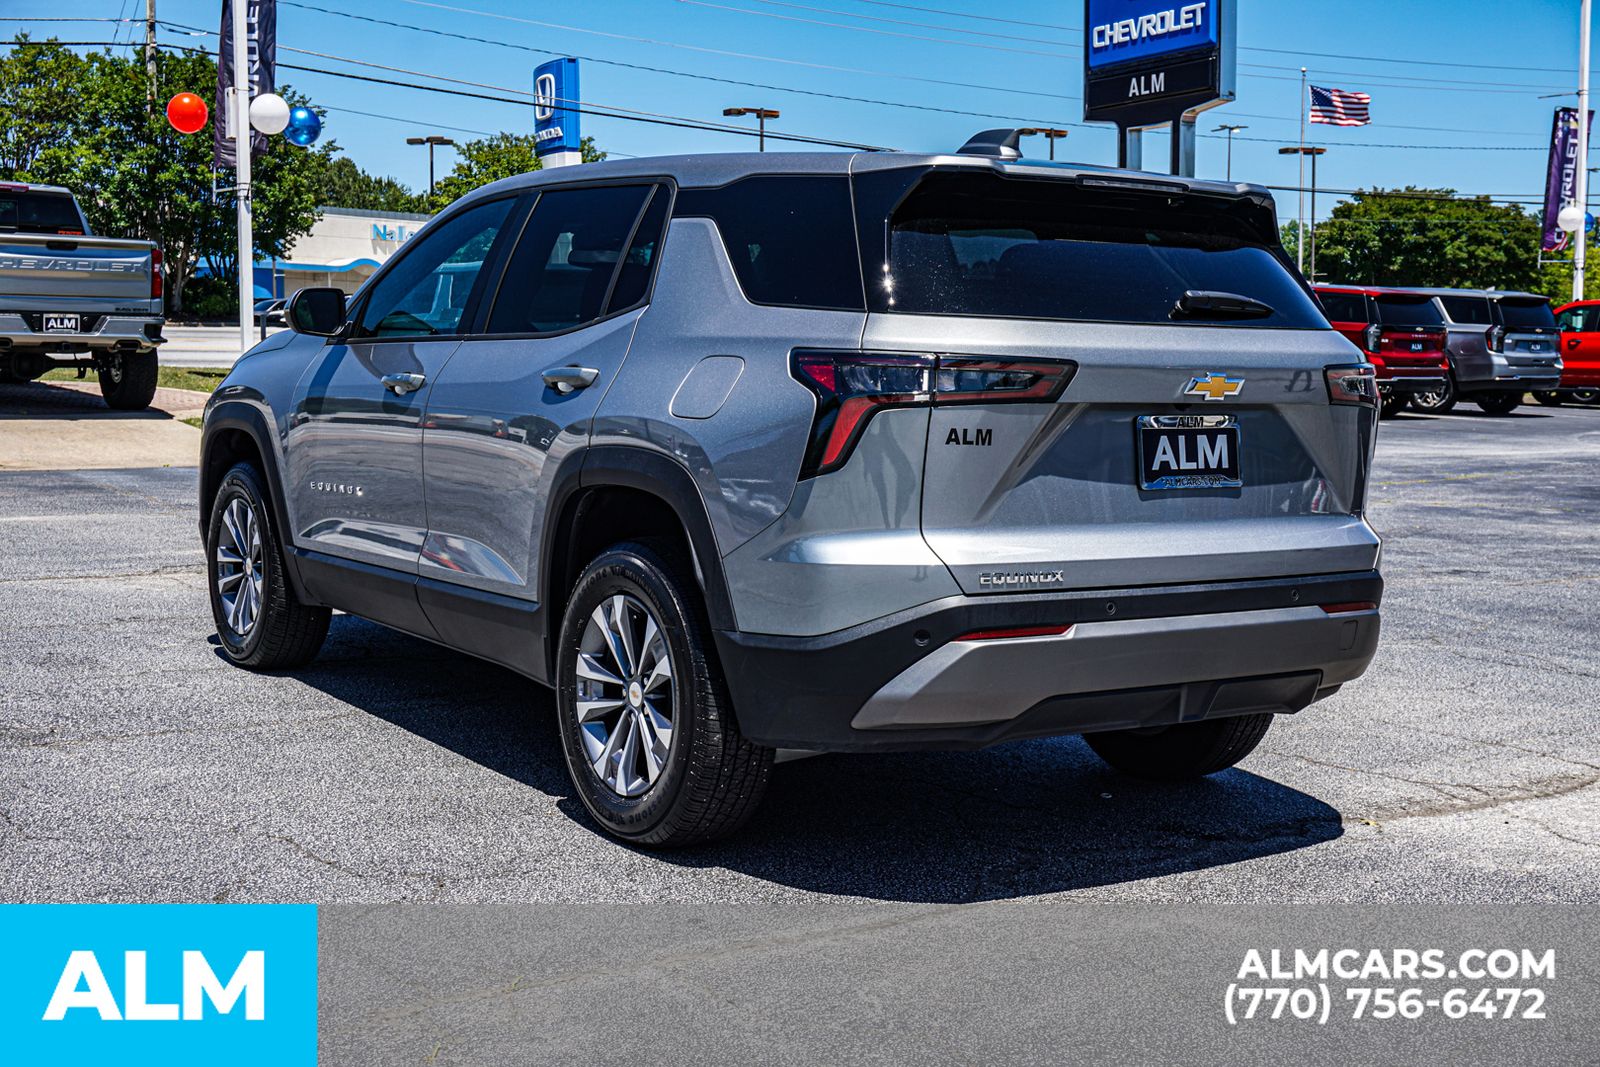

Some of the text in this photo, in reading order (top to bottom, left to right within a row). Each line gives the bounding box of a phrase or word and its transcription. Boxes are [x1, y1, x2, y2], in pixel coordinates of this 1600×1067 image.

[1093, 2, 1206, 48] CHEVROLET
[1128, 72, 1165, 97] ALM
[536, 126, 563, 142] NDA
[1554, 135, 1578, 243] CVROLET
[0, 258, 142, 272] HEVROLET
[47, 318, 76, 329] ALM
[1177, 416, 1204, 428] ALM
[946, 428, 992, 446] ALM
[1151, 434, 1229, 470] ALM
[980, 570, 1064, 585] EQUINOX
